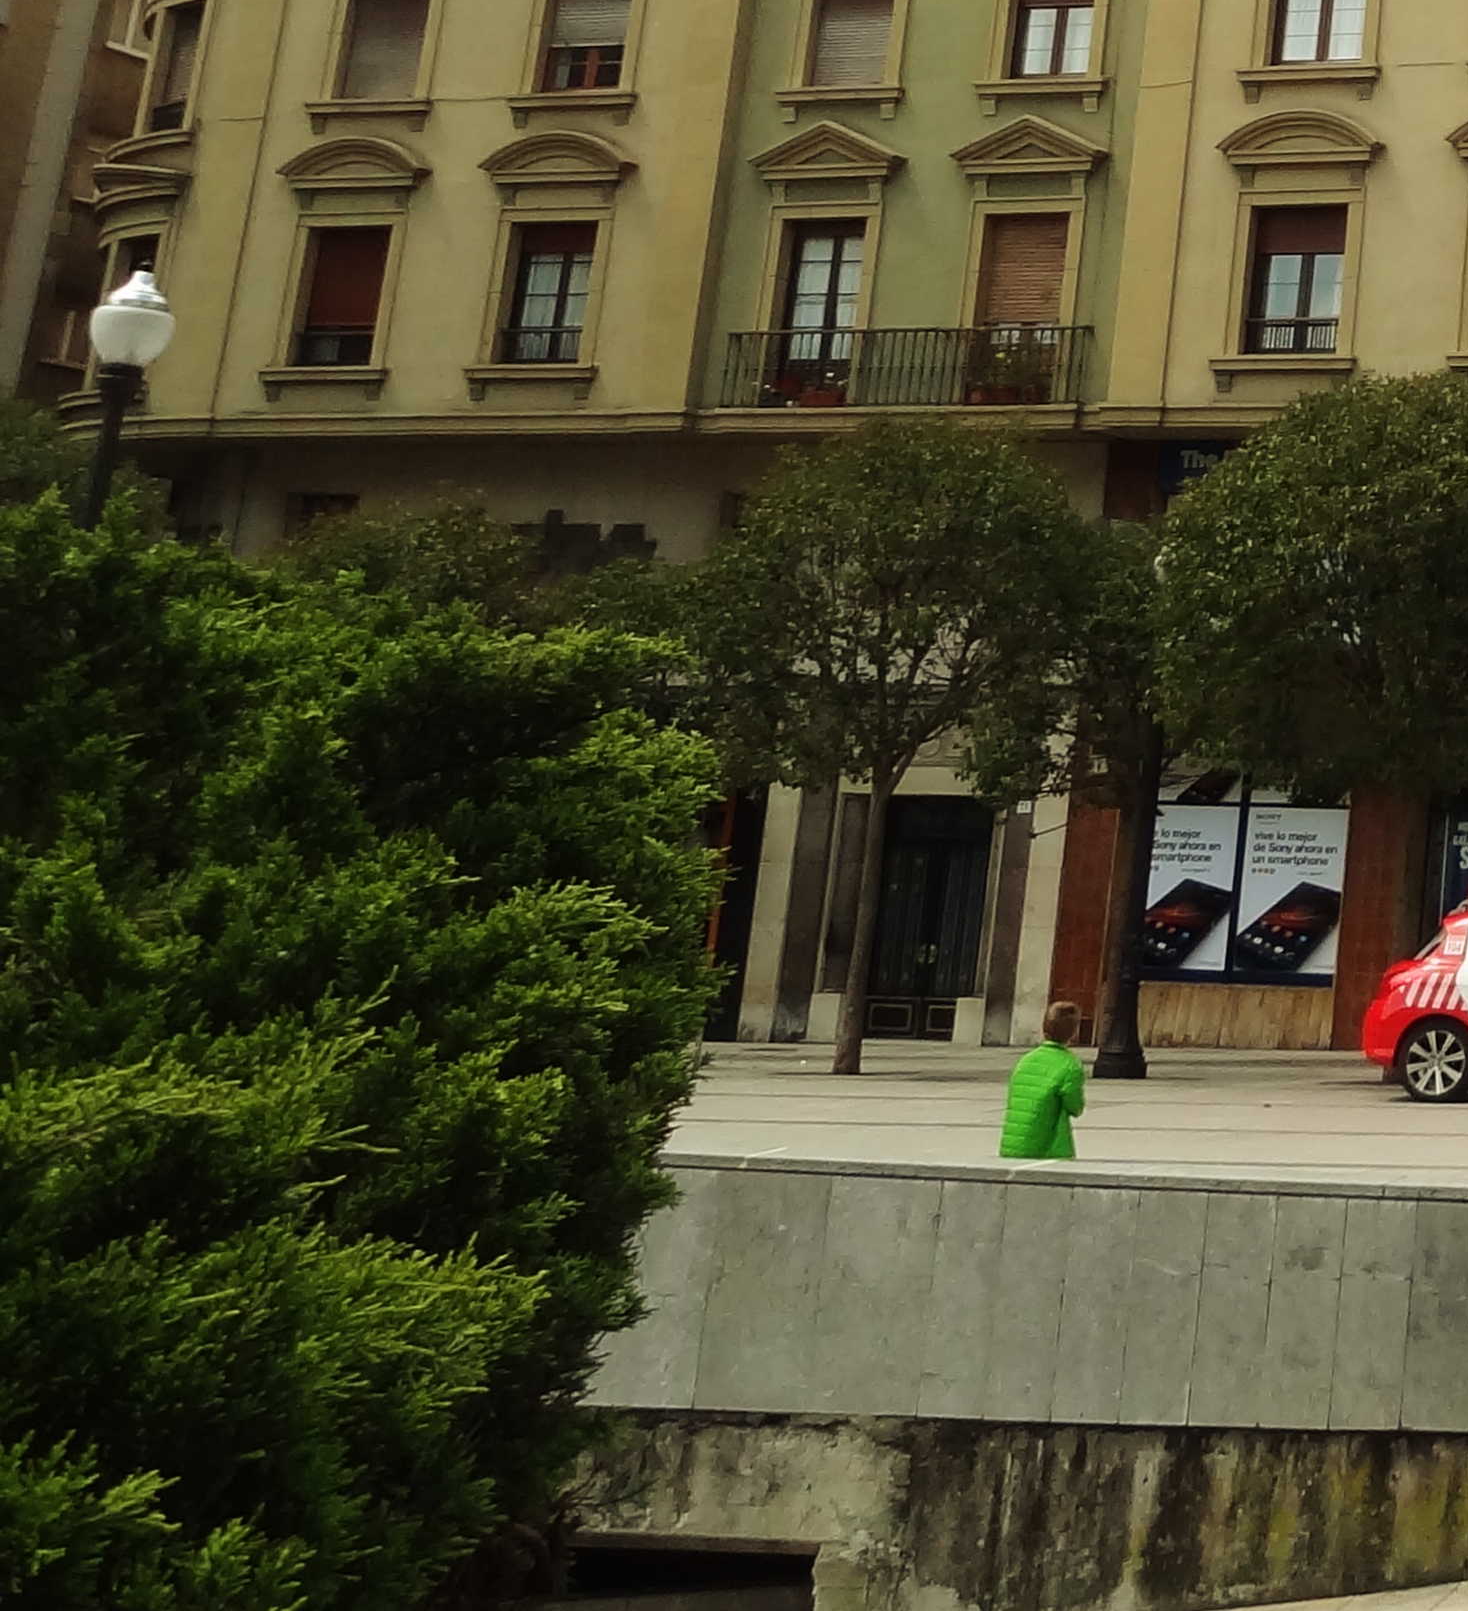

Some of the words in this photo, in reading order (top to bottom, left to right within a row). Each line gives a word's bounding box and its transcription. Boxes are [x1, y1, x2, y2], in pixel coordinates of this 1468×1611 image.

[1288, 833, 1318, 844] mejor
[1253, 842, 1266, 852] de
[1269, 842, 1292, 856] Sony
[1294, 843, 1323, 854] ahora
[1267, 855, 1329, 868] smartphone
